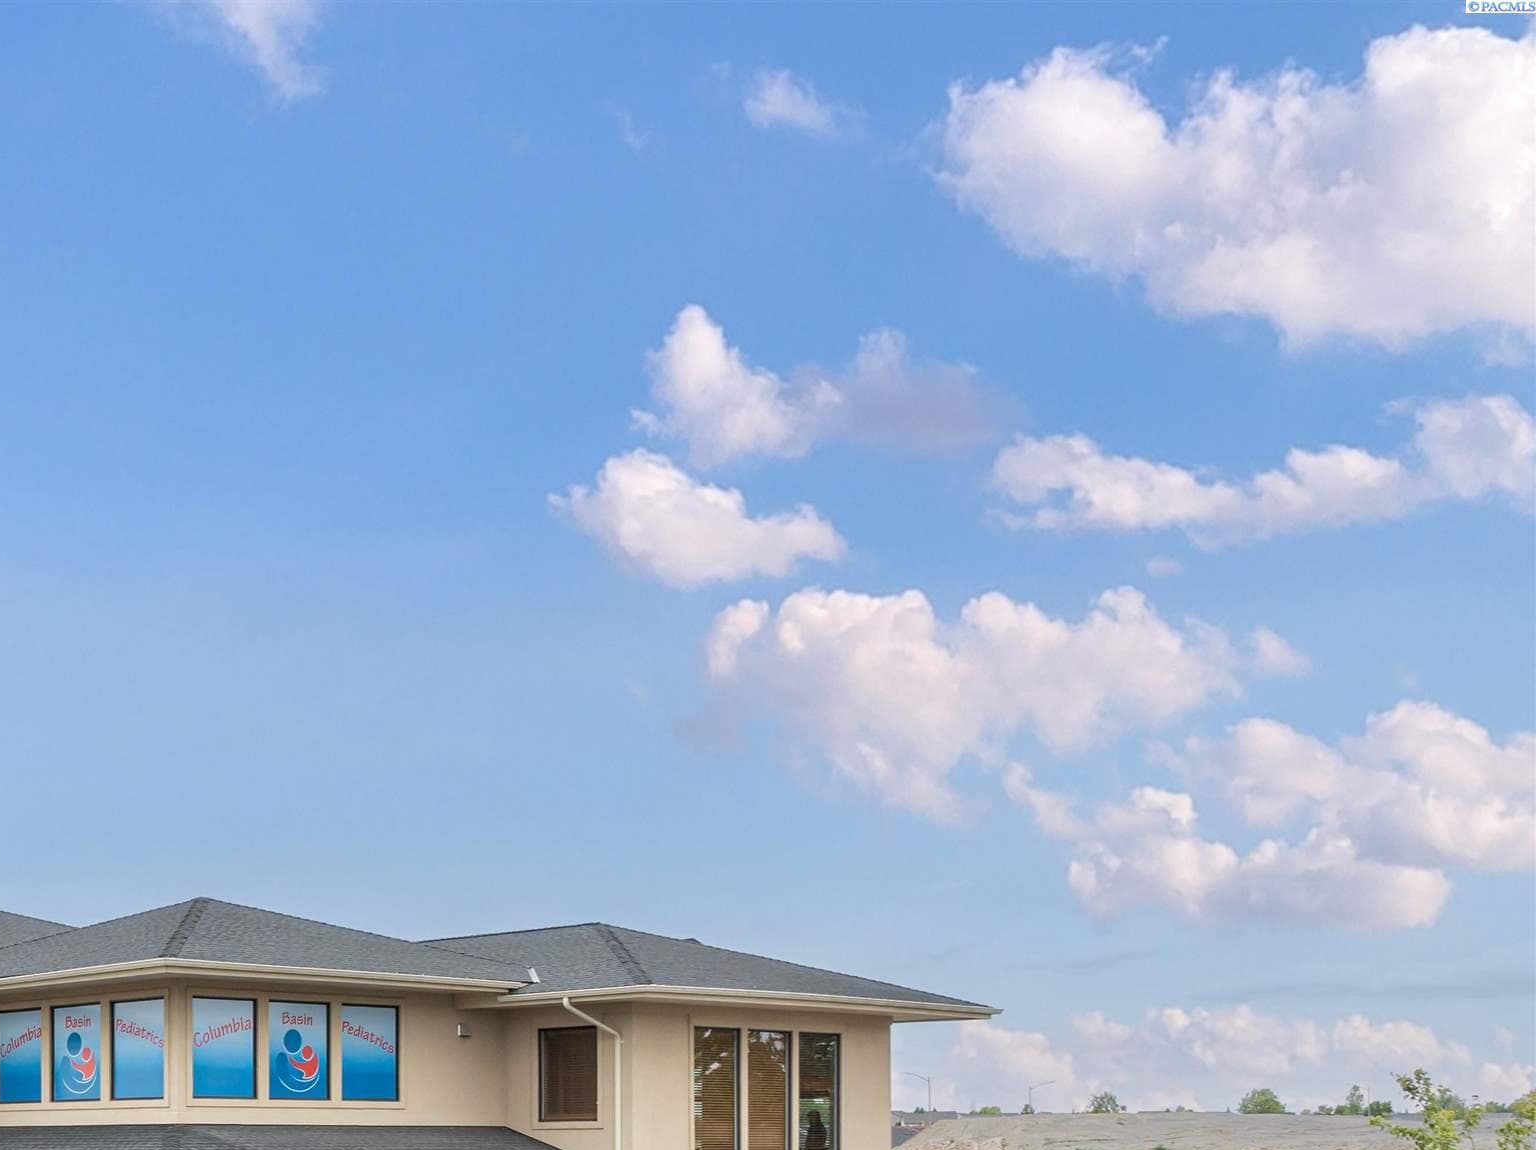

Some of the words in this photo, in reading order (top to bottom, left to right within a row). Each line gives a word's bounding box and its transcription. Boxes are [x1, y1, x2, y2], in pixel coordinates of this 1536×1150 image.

[0, 1025, 42, 1058] Columbia
[65, 1015, 91, 1029] Basin
[115, 1018, 164, 1049] Pediatrics
[193, 1016, 253, 1047] Columbia
[281, 1012, 313, 1026] Basin
[341, 1020, 395, 1054] Pediatrics
